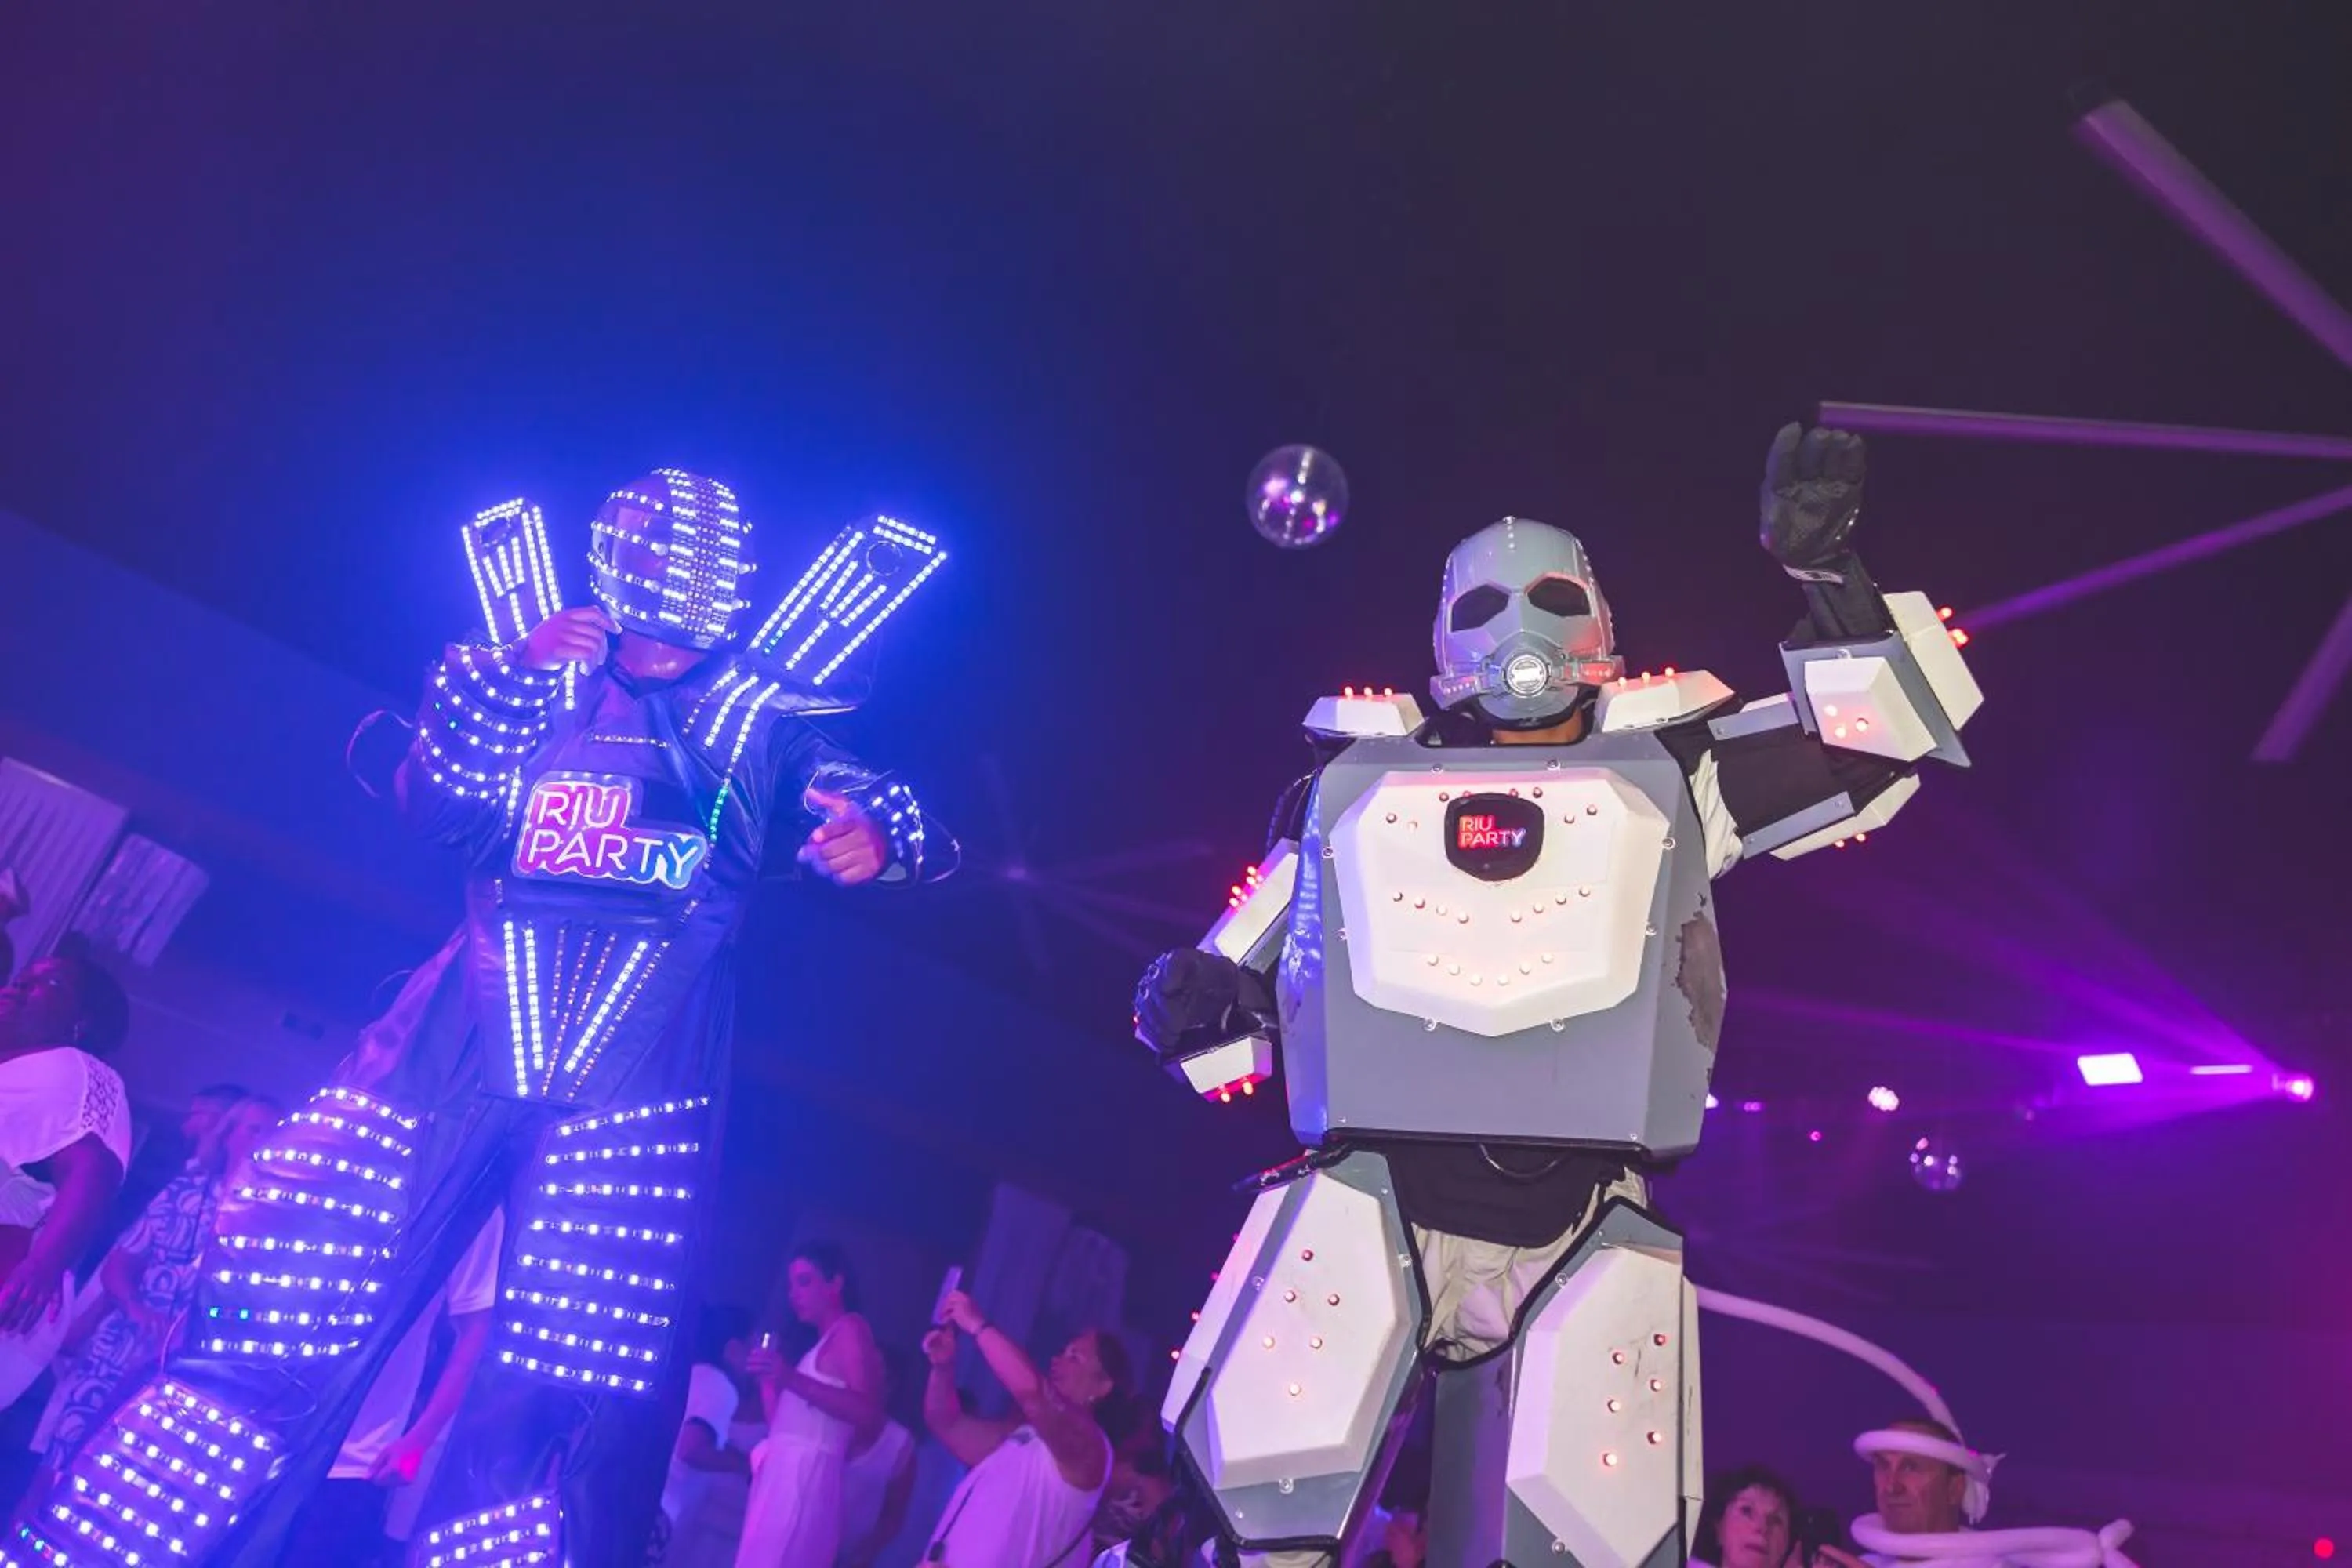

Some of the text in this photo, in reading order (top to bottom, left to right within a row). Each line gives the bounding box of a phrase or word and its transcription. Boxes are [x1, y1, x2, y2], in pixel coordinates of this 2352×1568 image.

[536, 791, 619, 830] RIU
[1461, 816, 1493, 832] RIU
[1461, 830, 1525, 845] PARTY
[527, 829, 698, 879] PARTY
